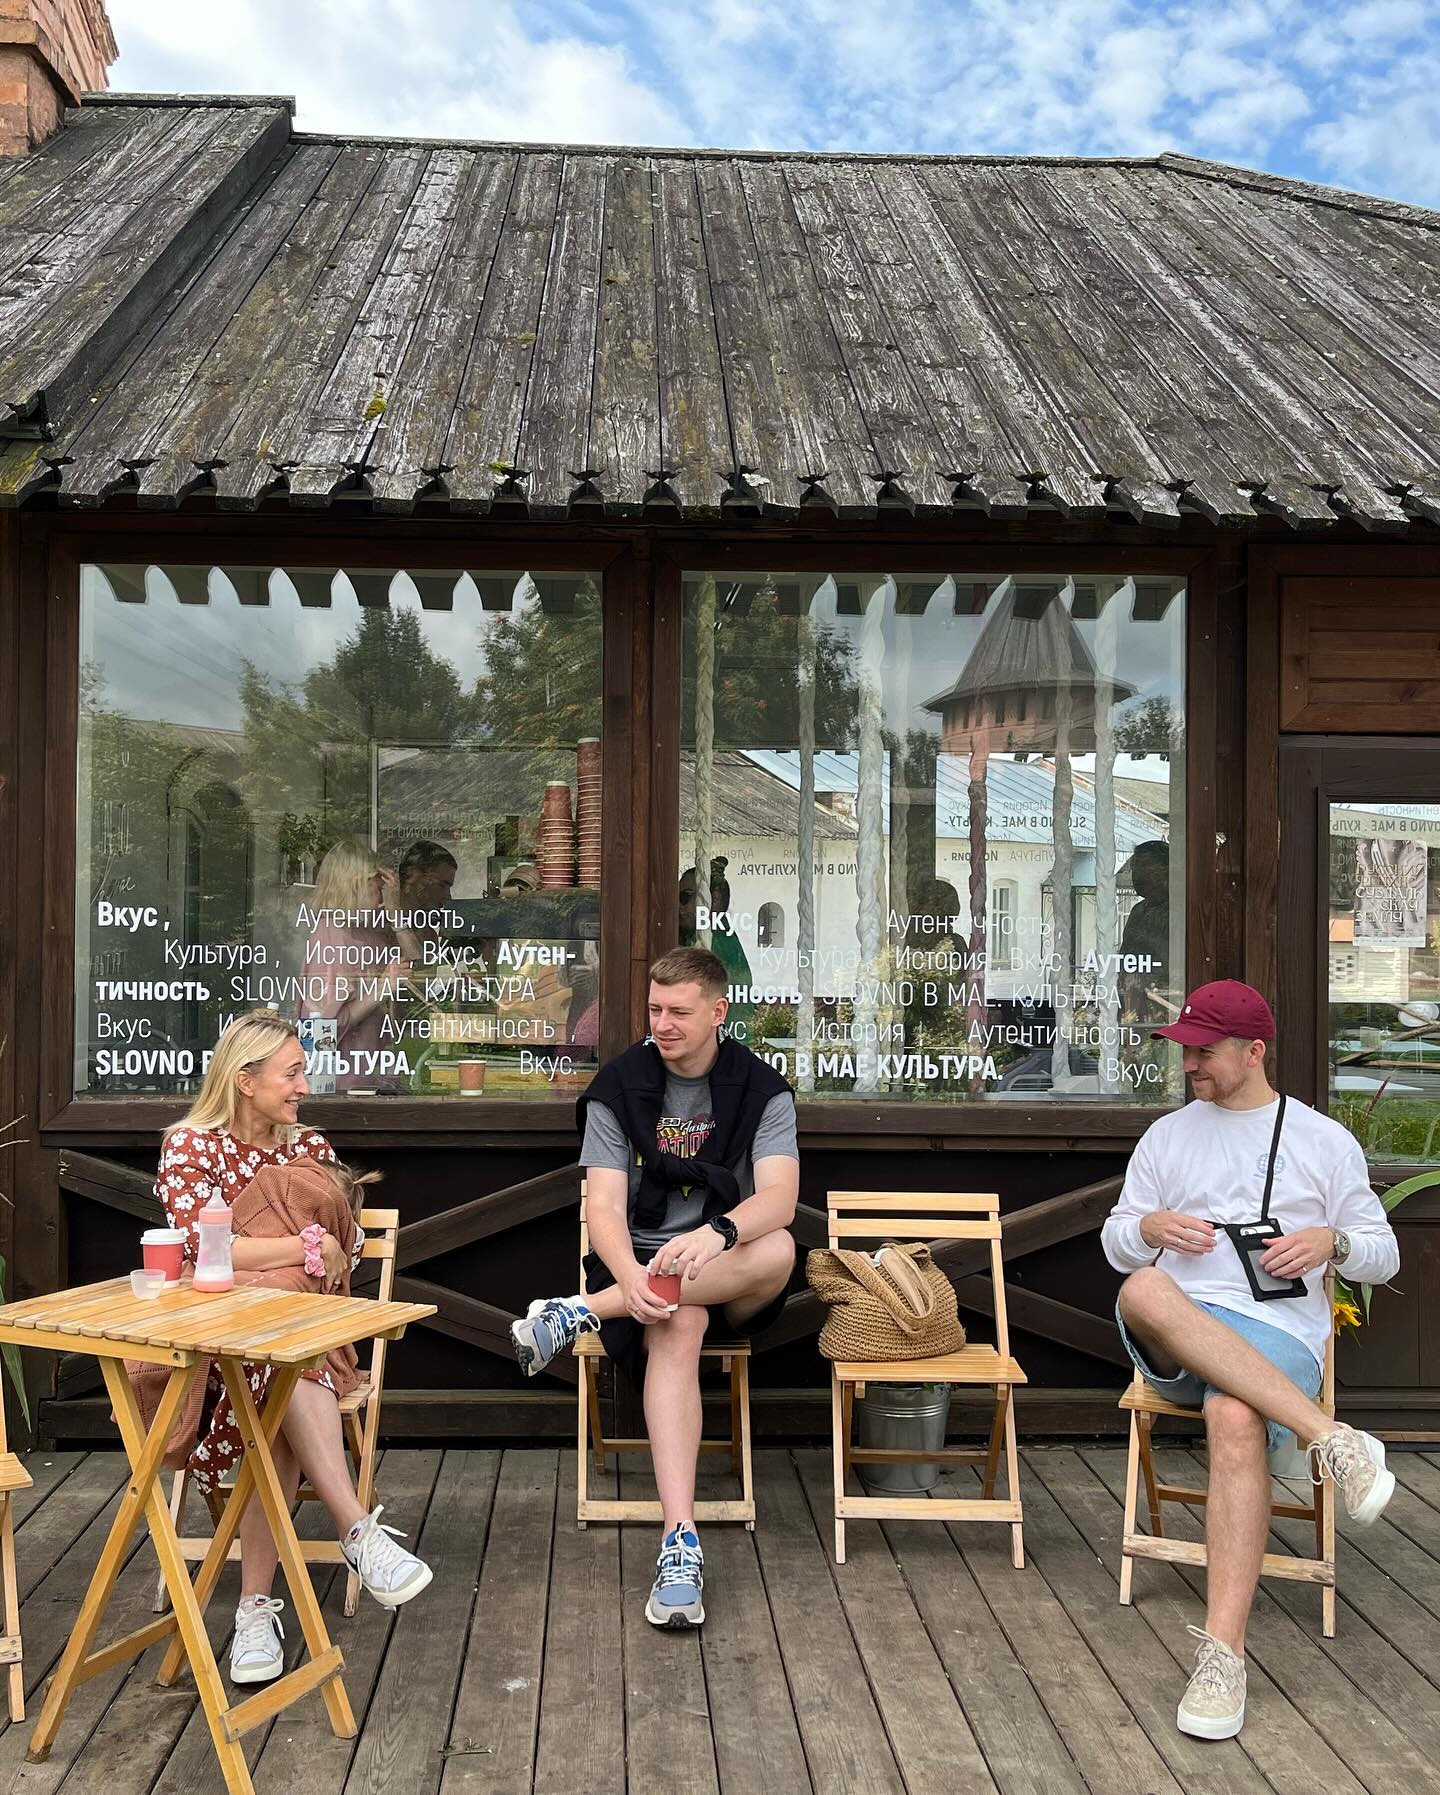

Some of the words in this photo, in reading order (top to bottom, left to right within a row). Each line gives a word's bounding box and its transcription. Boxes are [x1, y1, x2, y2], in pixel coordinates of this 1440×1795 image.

[98, 901, 159, 933] Вкус
[295, 902, 465, 934] Аутентичность
[695, 905, 754, 937] Вкус
[164, 938, 268, 970] Культура
[306, 939, 402, 971] История
[423, 939, 476, 971] Вкус
[496, 938, 577, 972] Аутен-
[759, 943, 858, 976] Культура
[895, 944, 988, 976] История
[1010, 946, 1064, 978] Вкус
[1083, 948, 1163, 979] Аутен-
[95, 981, 211, 1001] тичность
[230, 976, 326, 1002] SLOVNO
[335, 977, 350, 1002] В
[424, 976, 537, 1003] КУЛЬТУРА
[725, 984, 804, 1005] чность
[822, 982, 915, 1007] SLOVNO
[923, 983, 939, 1007] В
[1011, 984, 1123, 1010] КУЛЬТУРА
[97, 1012, 152, 1044] Вкус
[379, 1013, 556, 1045] Аутентичность
[810, 1015, 906, 1049] История
[967, 1018, 1143, 1050] Аутентичность
[95, 1050, 195, 1076] SLOVNO
[303, 1050, 417, 1077] УЛЬТУРА.
[519, 1050, 578, 1082] Вкус.
[795, 1052, 811, 1078] В
[876, 1053, 1004, 1082] КУЛЬТУРА.
[1106, 1057, 1164, 1089] Вкус.
